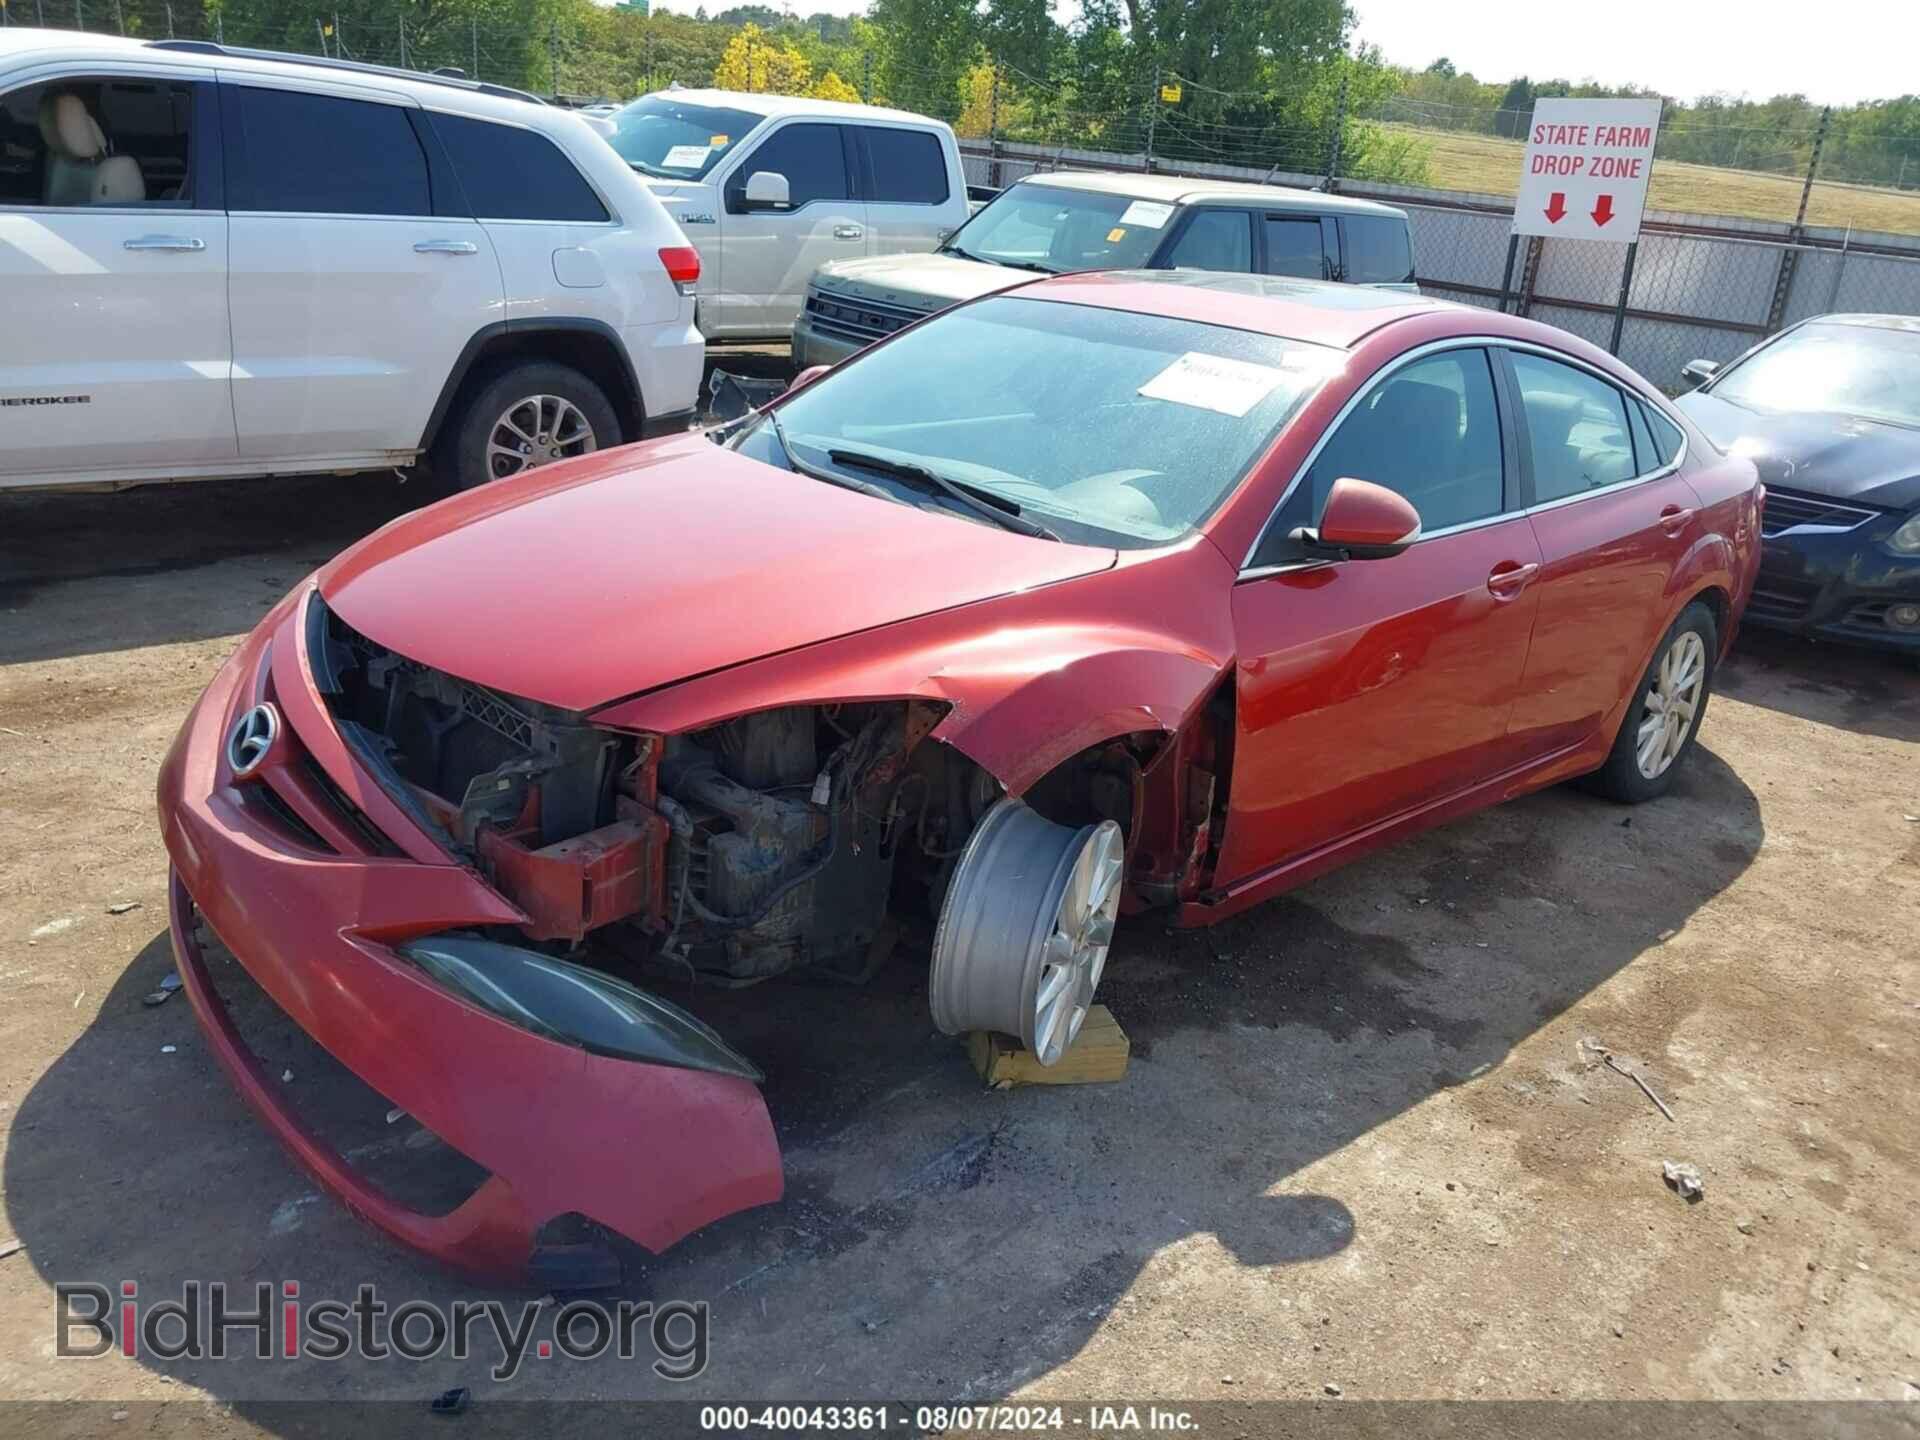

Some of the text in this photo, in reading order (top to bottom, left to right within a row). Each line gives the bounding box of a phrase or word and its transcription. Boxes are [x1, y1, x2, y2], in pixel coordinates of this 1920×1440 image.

[1533, 125, 1651, 148] STATE FARM
[1531, 154, 1642, 178] DROP ZONE
